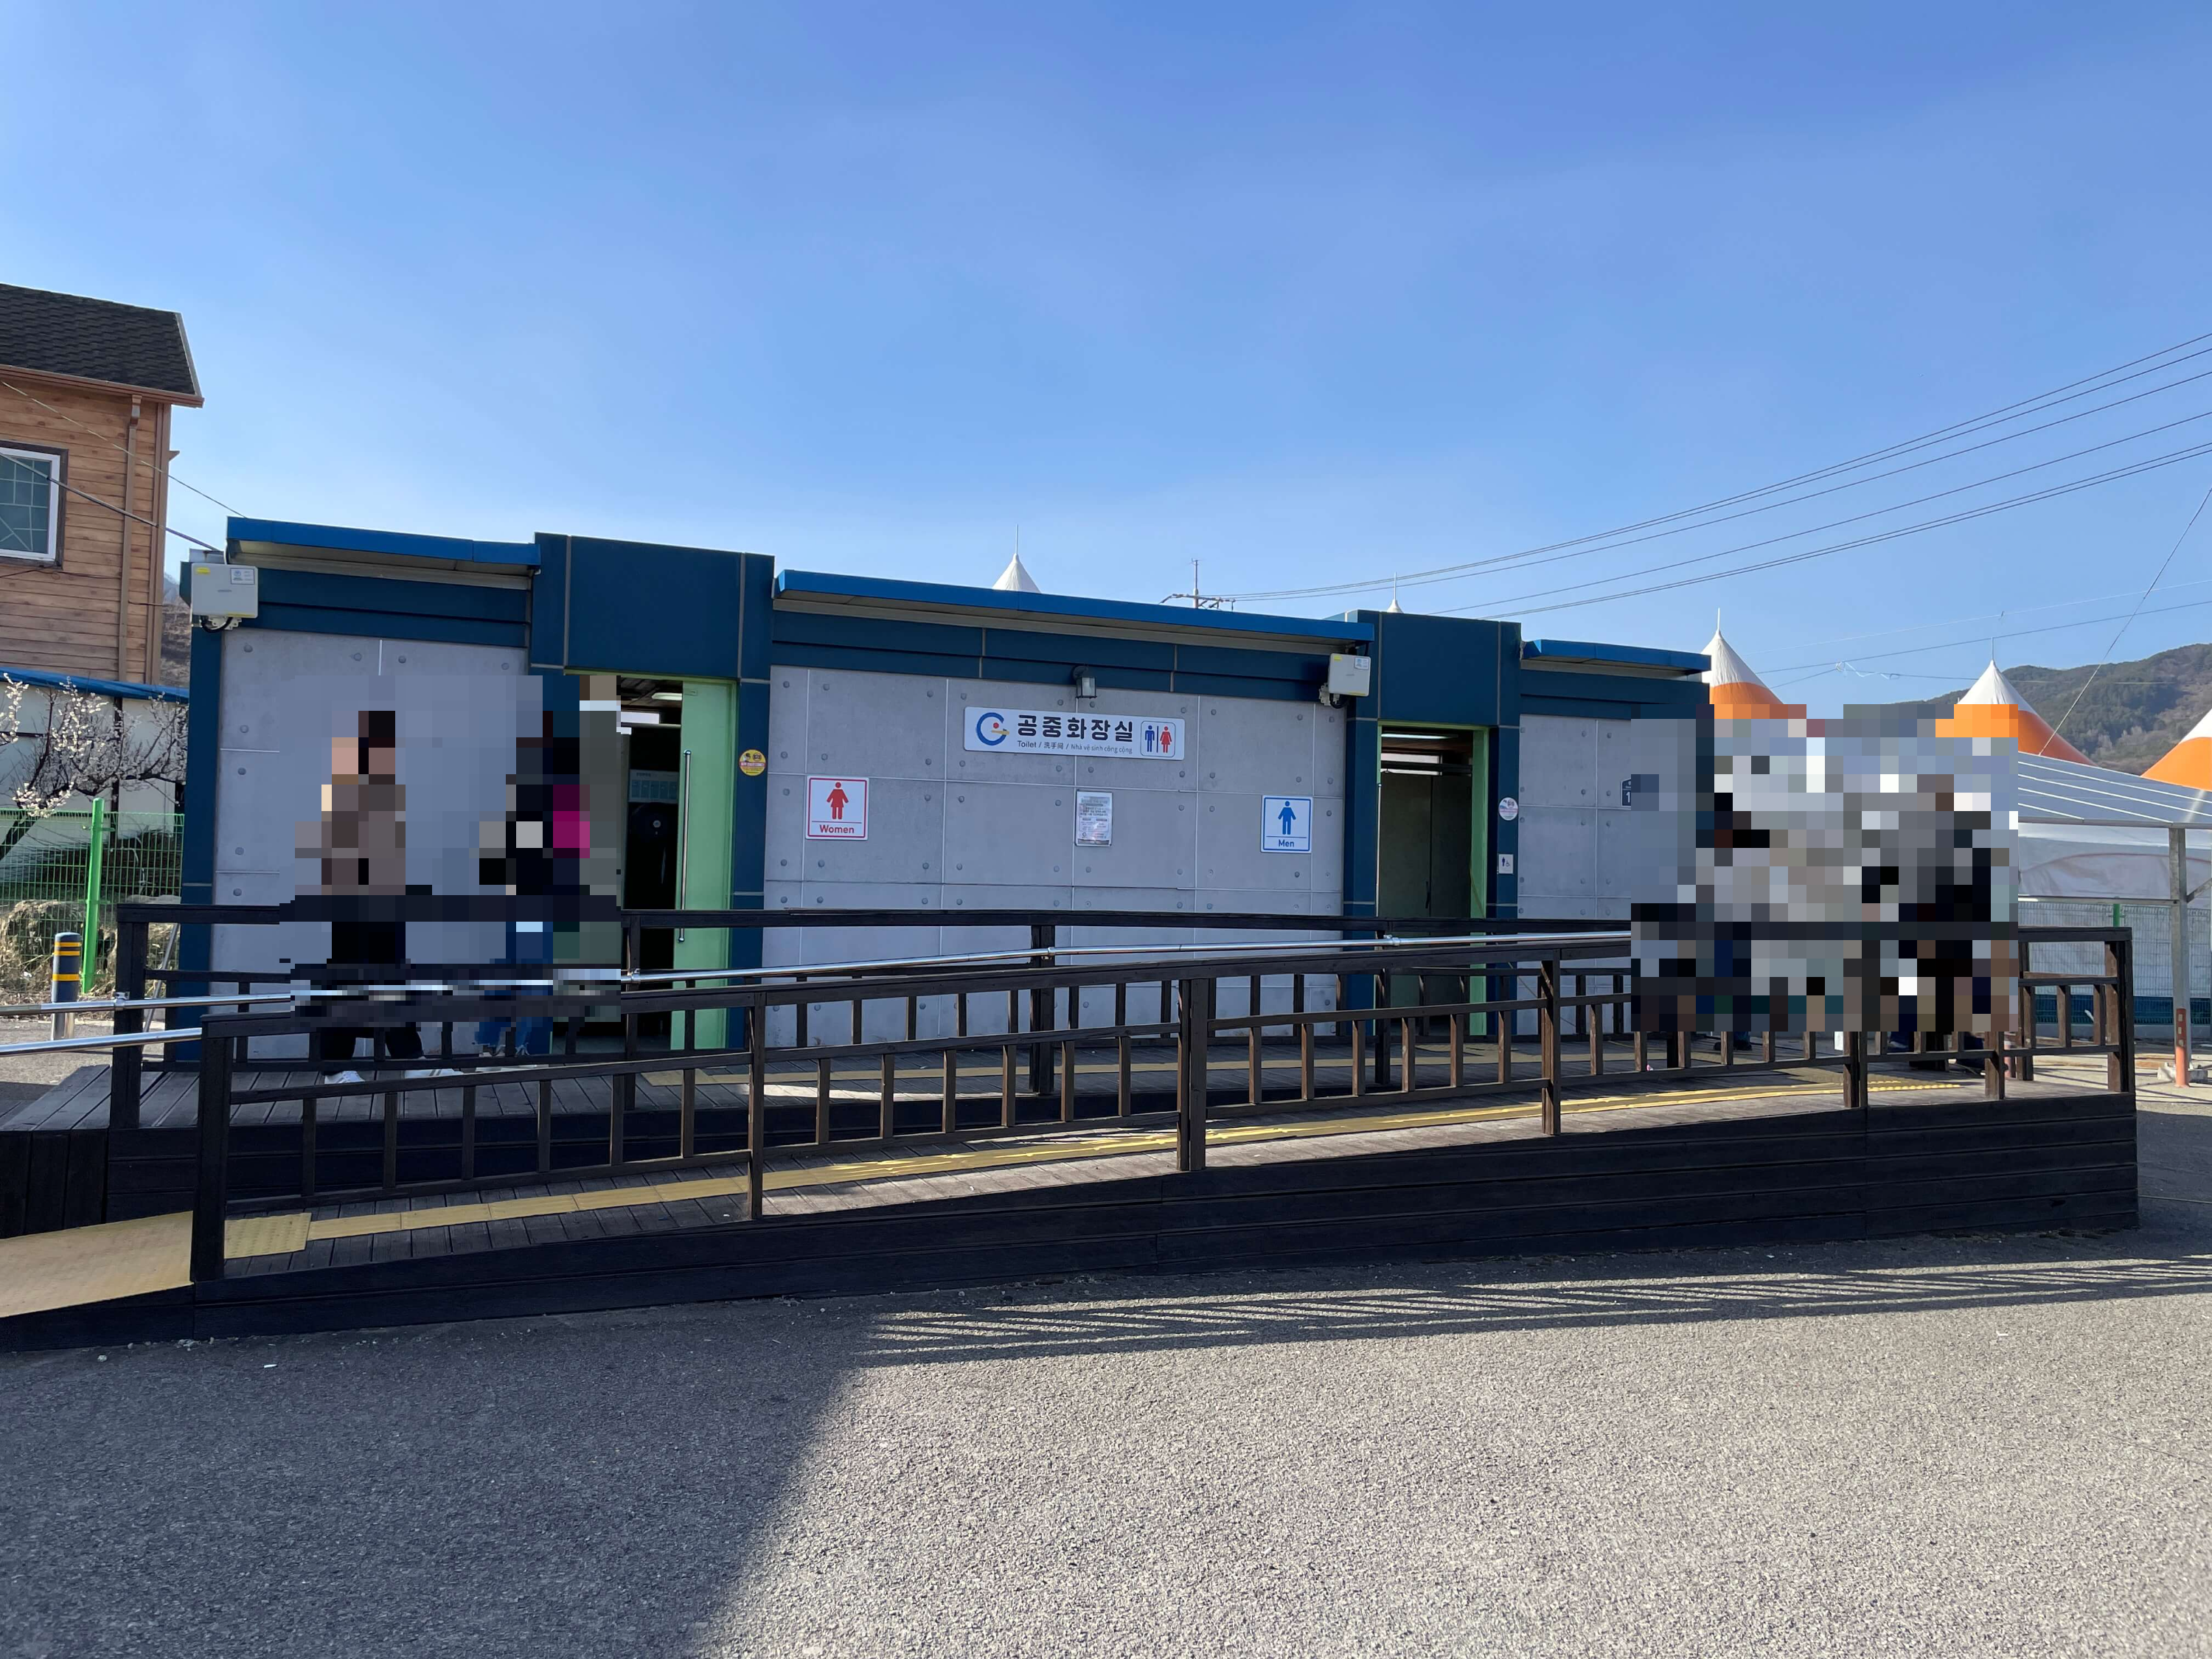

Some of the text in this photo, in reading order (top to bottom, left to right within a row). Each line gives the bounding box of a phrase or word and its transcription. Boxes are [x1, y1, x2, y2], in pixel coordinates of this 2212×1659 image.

[1018, 714, 1133, 742] 공중화장실
[1018, 740, 1037, 748] Toilet
[1043, 742, 1063, 750] 洗手间
[1104, 745, 1118, 754] công
[1119, 745, 1133, 754] cộng
[819, 824, 855, 833] Women
[1278, 839, 1295, 847] Men
